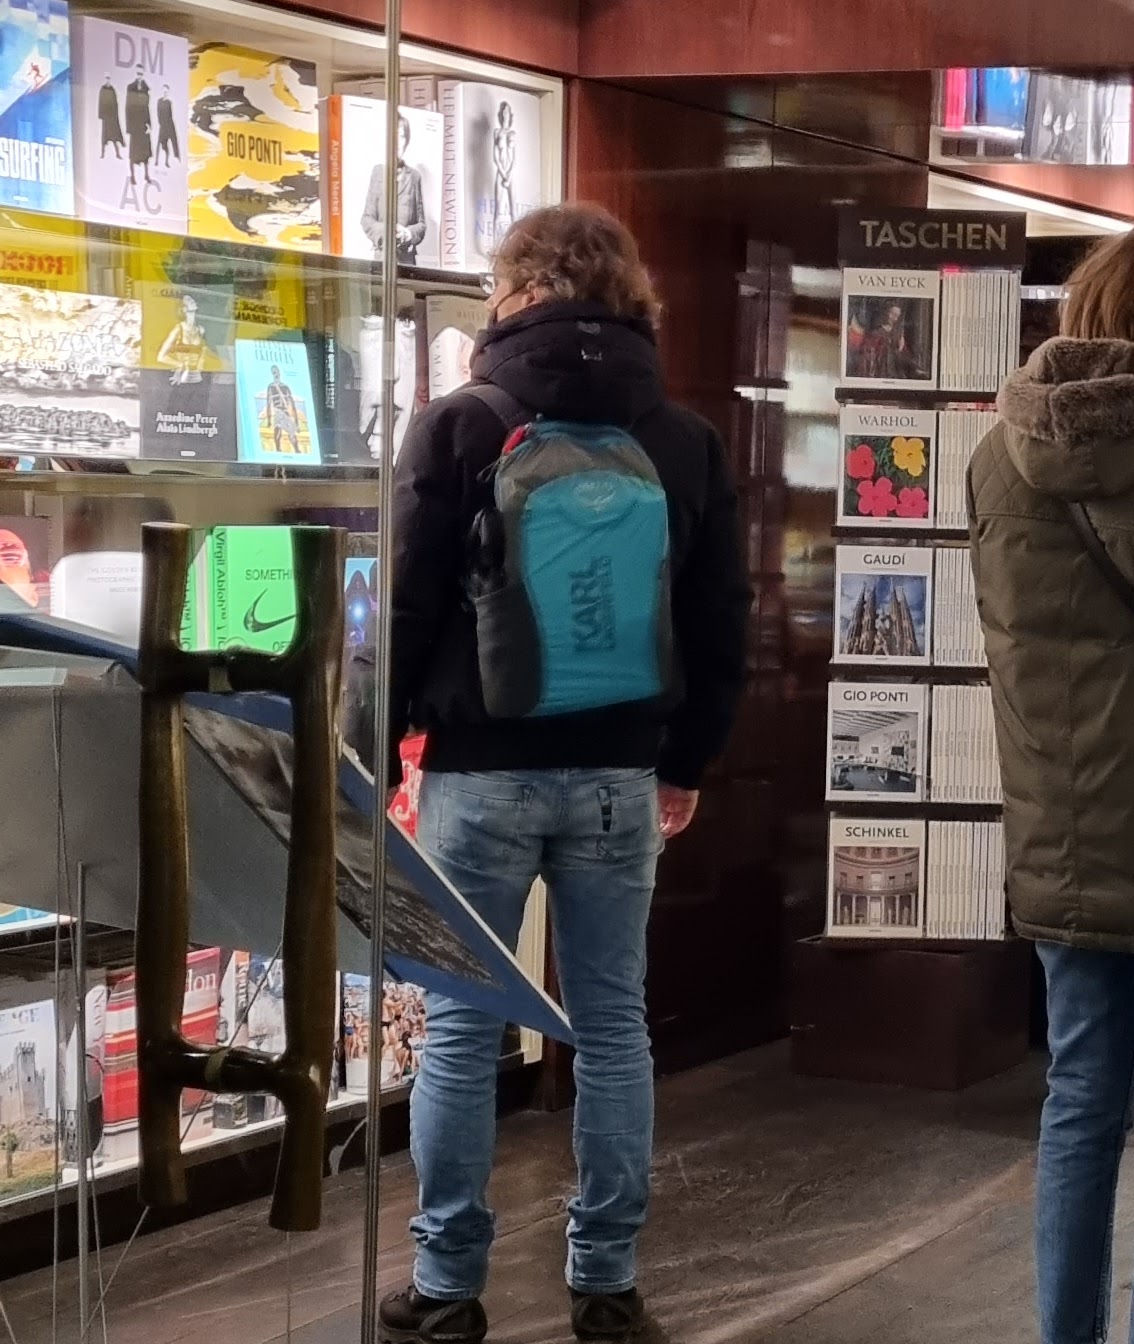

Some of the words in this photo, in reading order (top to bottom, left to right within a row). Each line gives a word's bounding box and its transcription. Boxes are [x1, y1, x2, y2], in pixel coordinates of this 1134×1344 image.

[114, 31, 164, 76] DM
[443, 88, 455, 163] HELMUT
[0, 137, 66, 186] SURFING
[226, 131, 245, 158] GIO
[248, 135, 282, 166] PONTI
[330, 139, 340, 178] Angela
[445, 172, 458, 250] NEWTON
[859, 220, 1007, 251] TASCHEN
[858, 275, 886, 288] VAN
[891, 276, 926, 289] EYCK
[178, 423, 218, 437] Lindbergh
[195, 412, 218, 424] Peter
[858, 415, 918, 428] WARHOL
[214, 531, 226, 564] Virgil
[863, 552, 906, 566] GAUDÍ
[567, 555, 603, 652] KARL
[843, 690, 867, 702] GIO
[870, 691, 909, 703] PONTI
[845, 826, 909, 839] SCHINKEL
